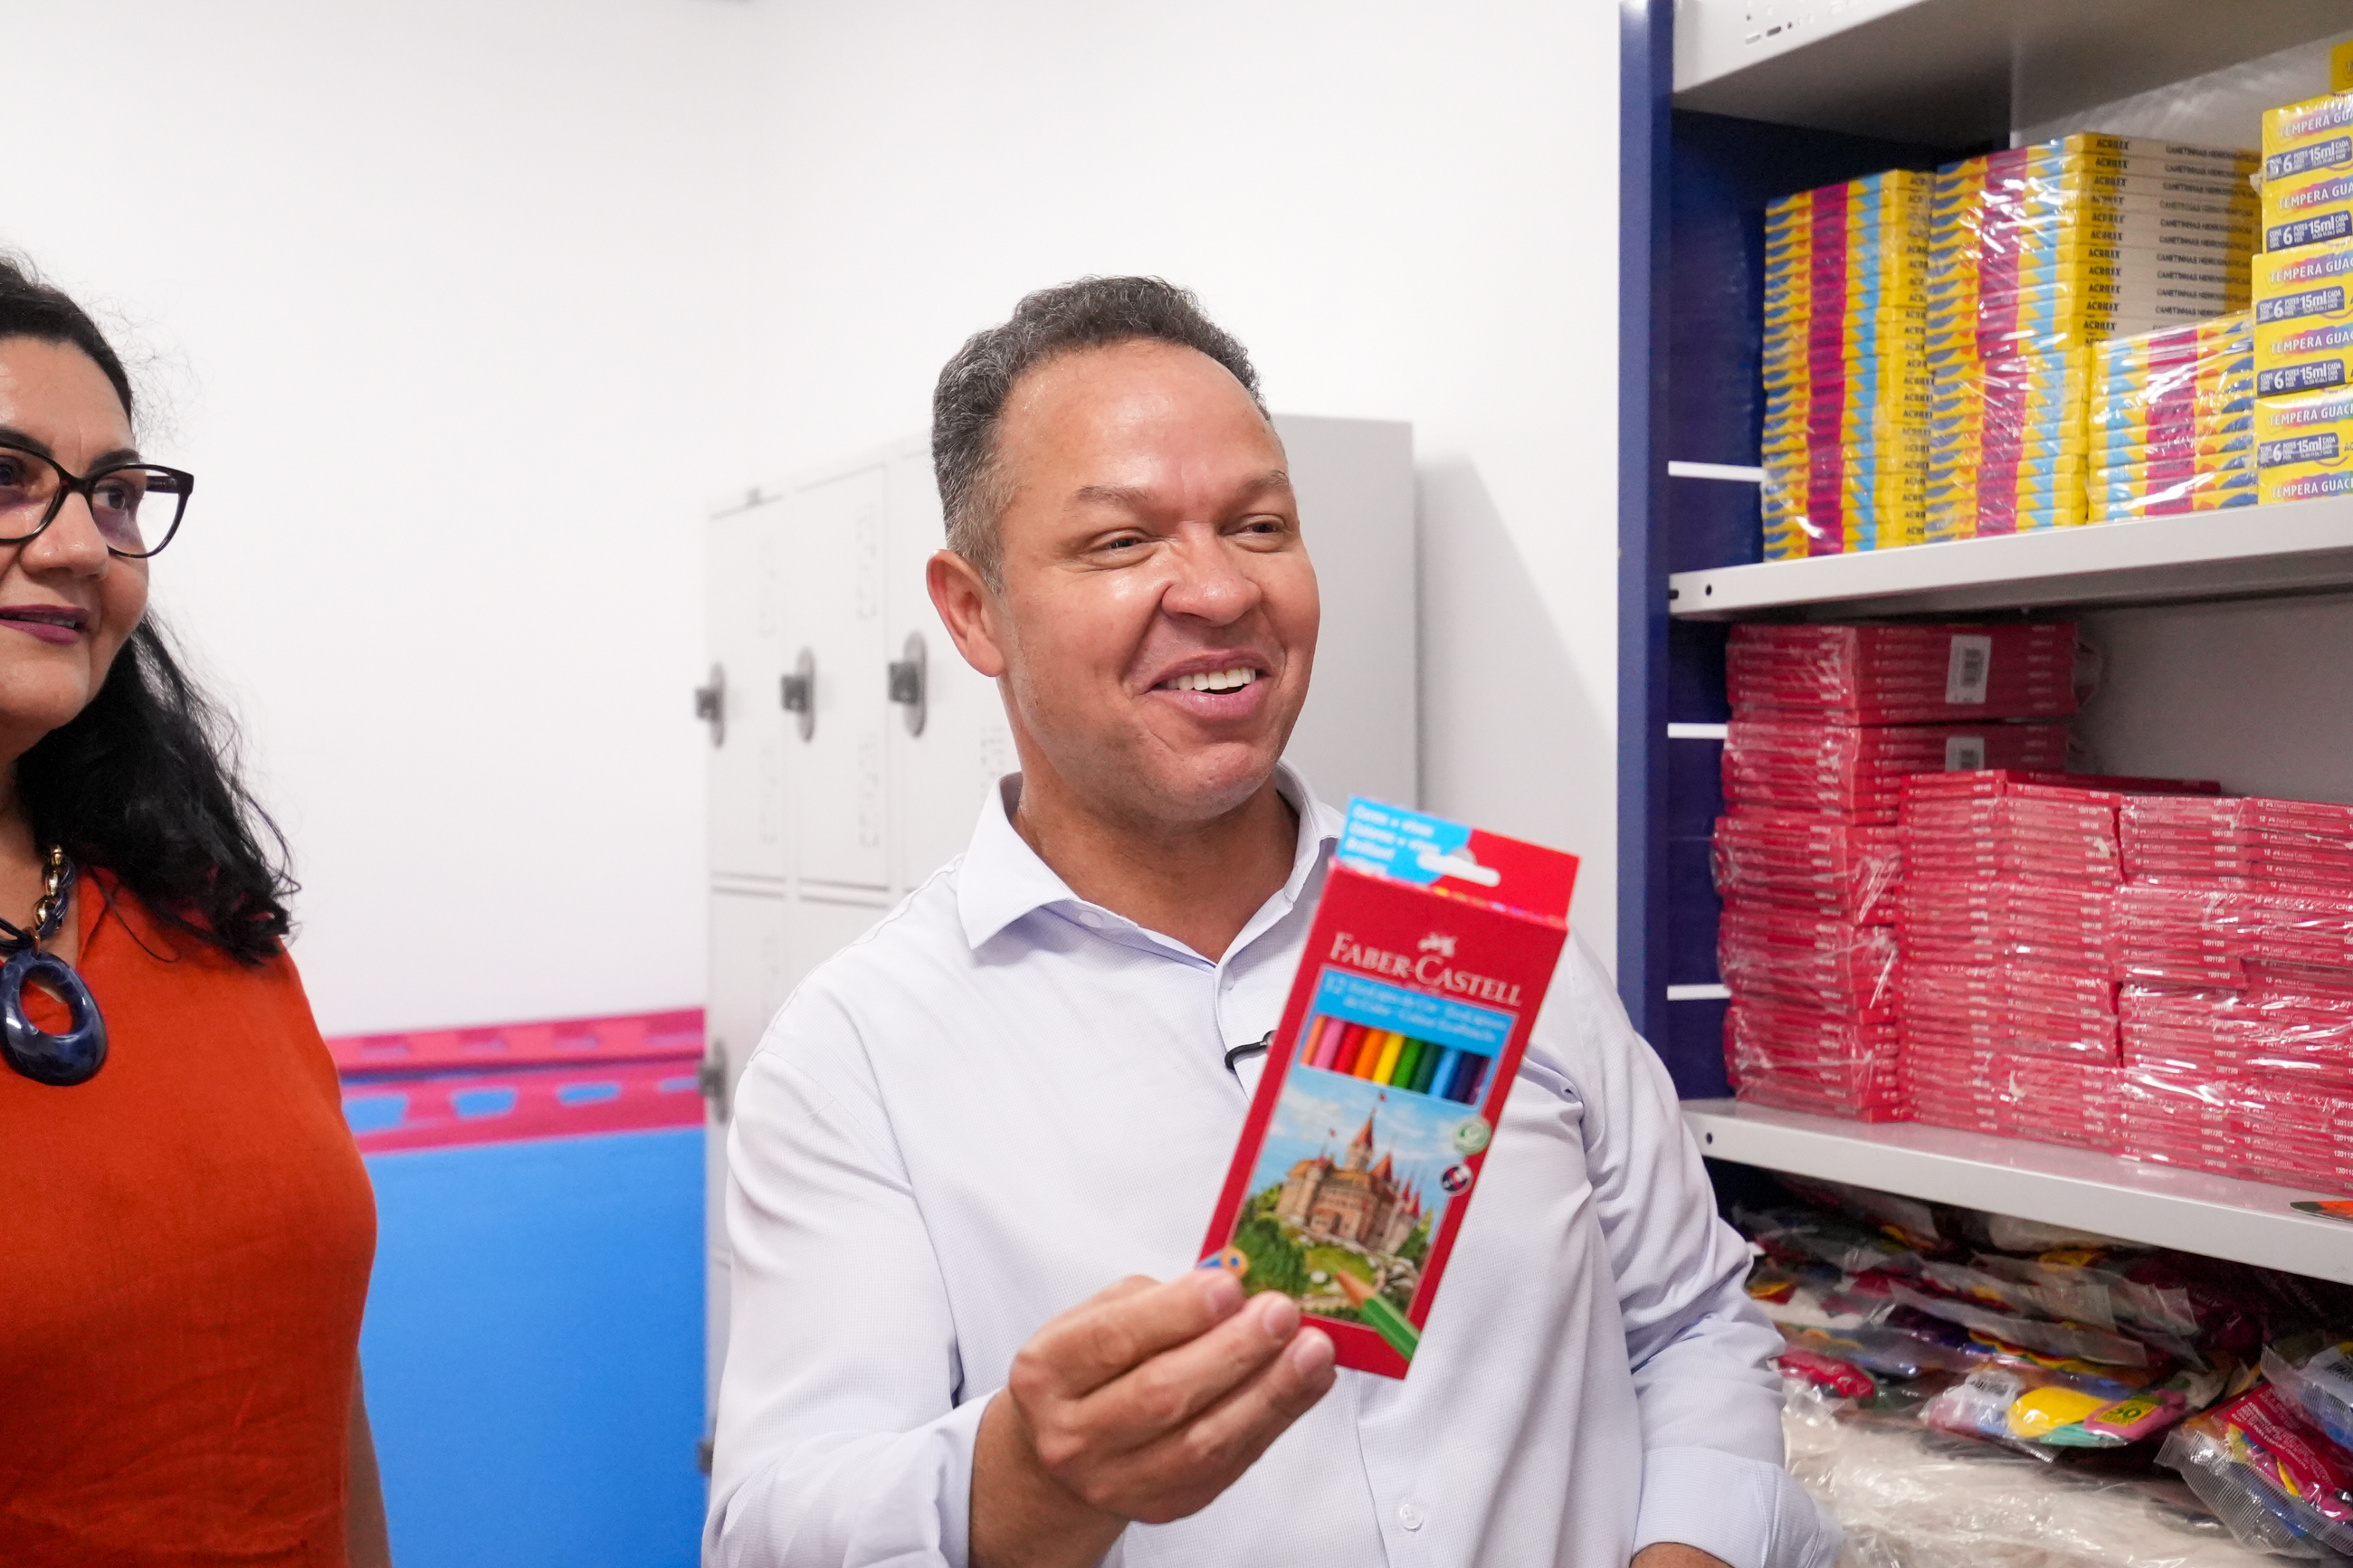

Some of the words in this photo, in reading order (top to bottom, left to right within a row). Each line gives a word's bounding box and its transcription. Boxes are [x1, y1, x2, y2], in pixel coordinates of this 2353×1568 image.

[2280, 115, 2330, 138] TEMPERA
[2282, 154, 2292, 173] 6
[2309, 142, 2335, 162] 15ml
[2279, 188, 2329, 210] TEMPERA
[2282, 226, 2292, 245] 6
[2309, 215, 2334, 234] 15ml
[2089, 249, 2120, 259] ACRILEX
[2270, 263, 2322, 283] TEMPERA
[2274, 300, 2284, 318] 6
[2300, 291, 2327, 308] 15ml
[2271, 336, 2322, 354] TEMPERA
[2274, 371, 2284, 389] 6
[2300, 363, 2327, 380] 15ml
[2270, 409, 2318, 426] TEMPERA
[2272, 443, 2282, 462] 6
[2296, 436, 2322, 452] 15ml
[2272, 482, 2318, 499] TEMPERA
[1329, 932, 1522, 1007] FABER-CASTELL
